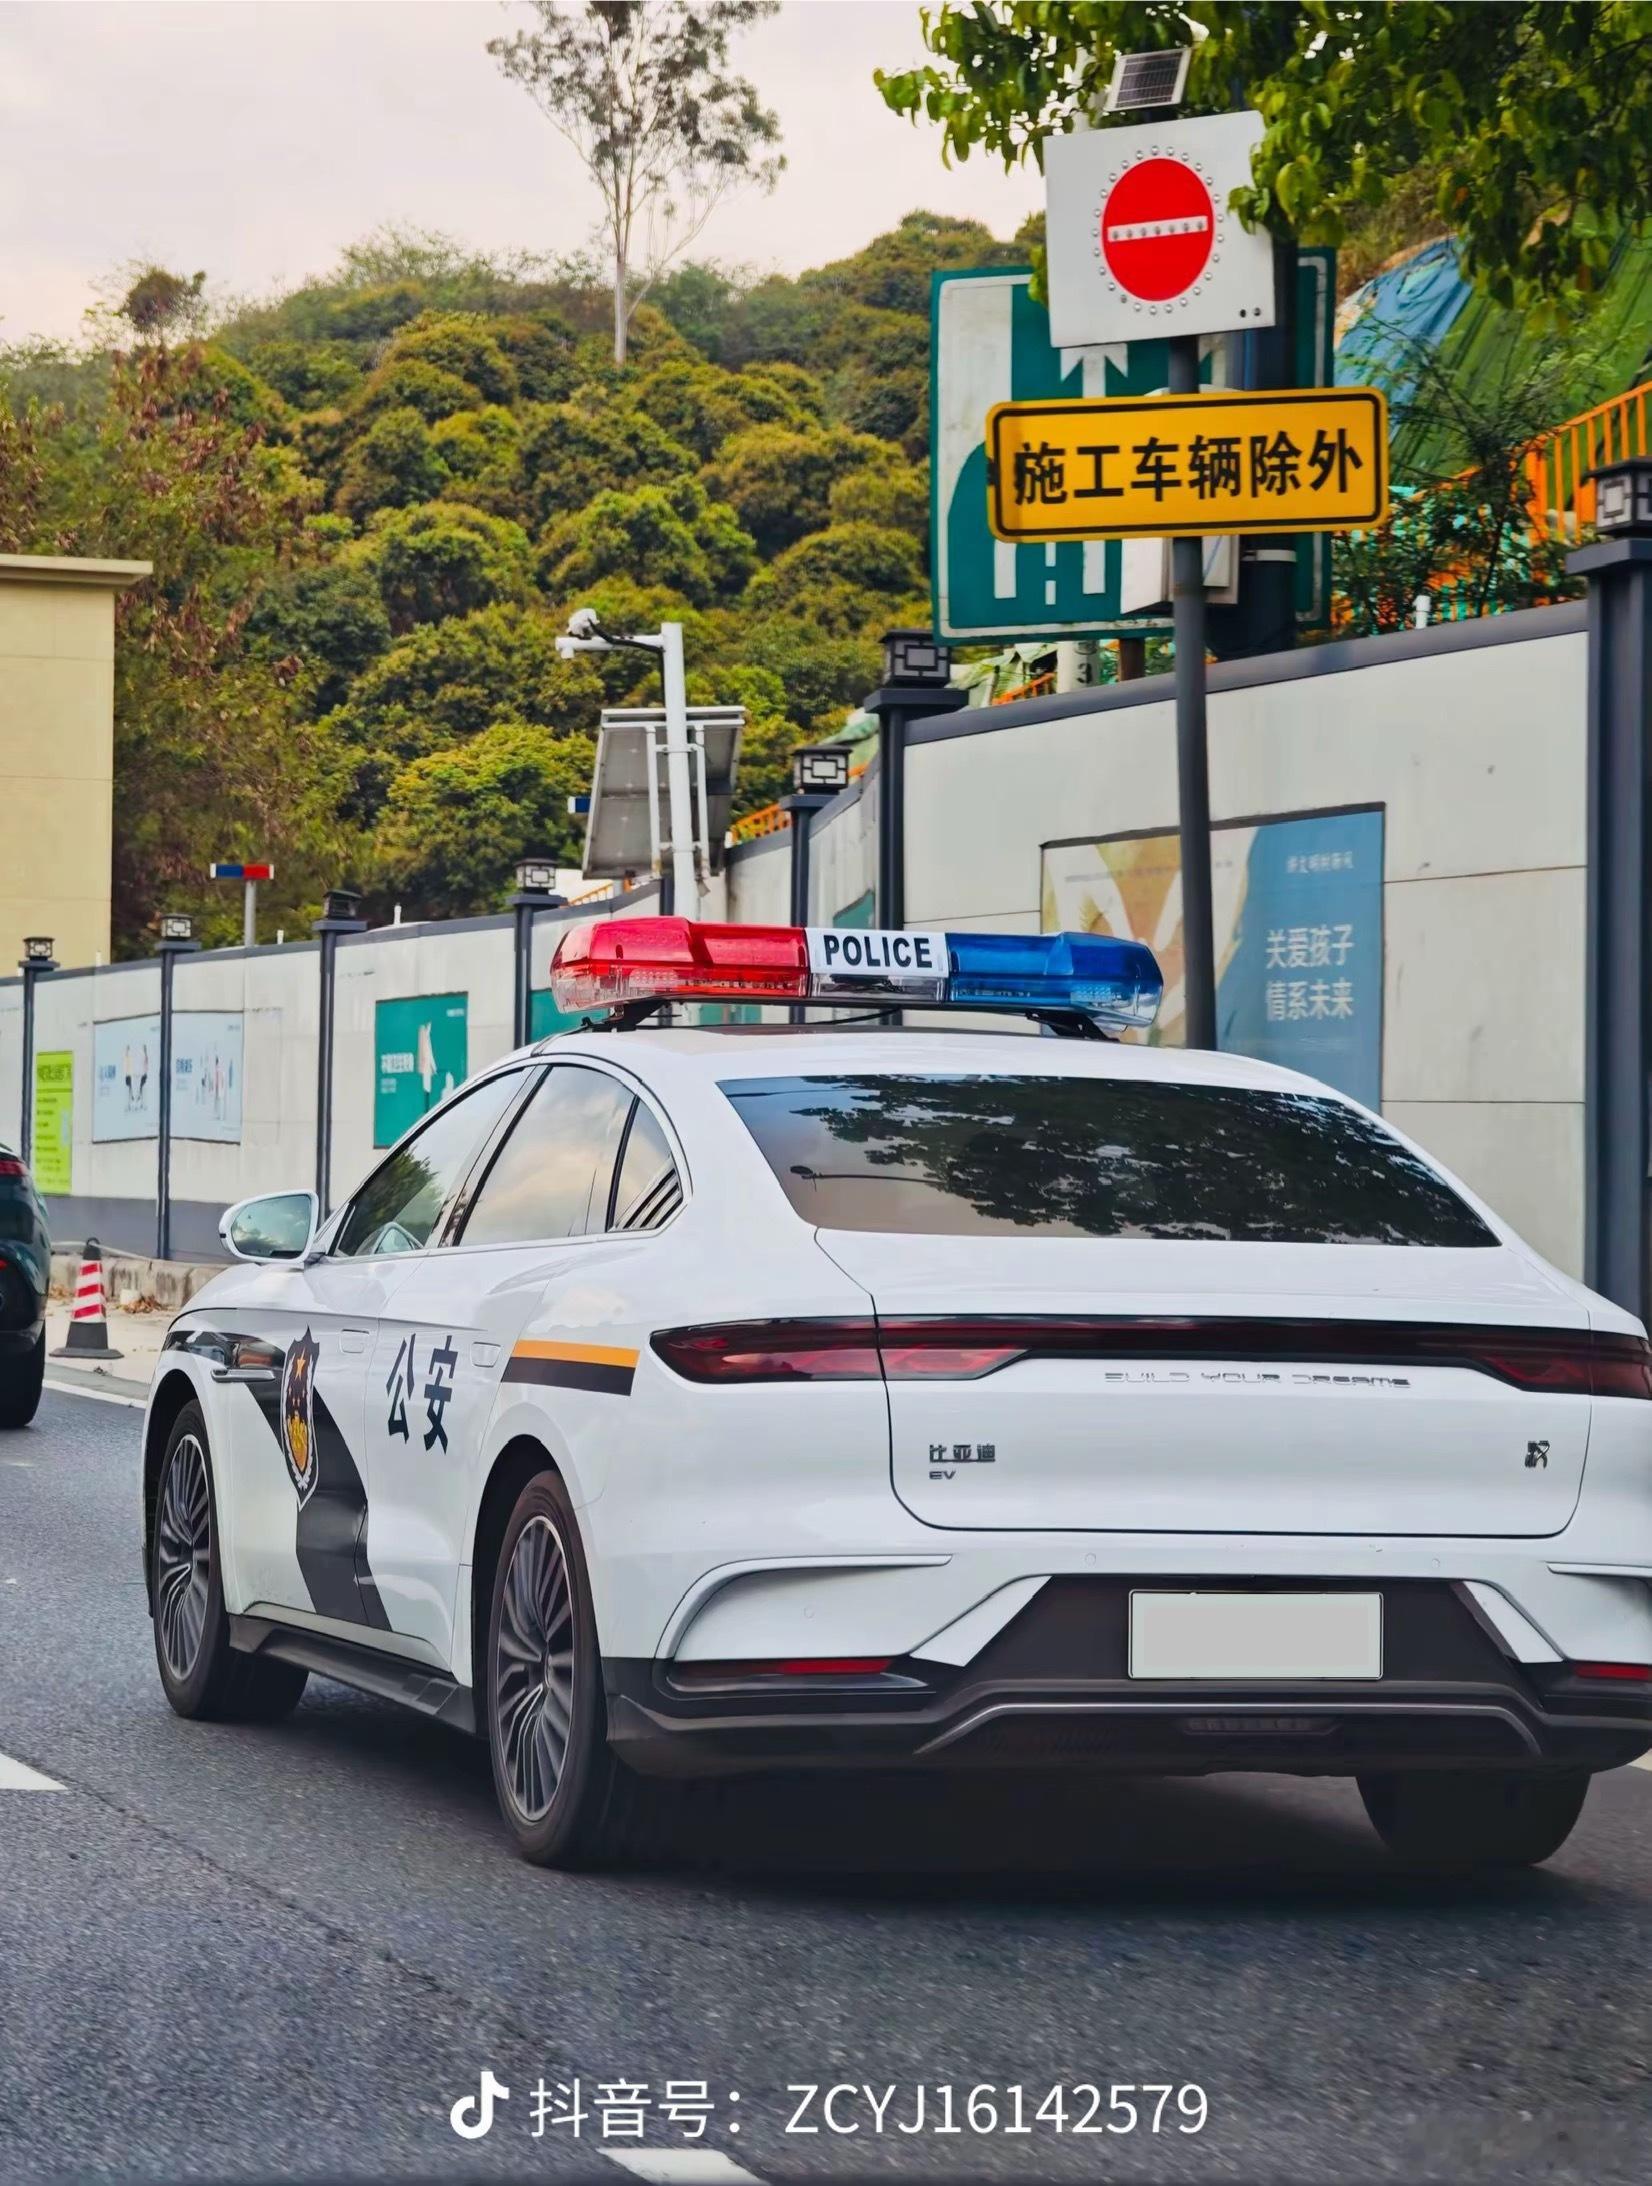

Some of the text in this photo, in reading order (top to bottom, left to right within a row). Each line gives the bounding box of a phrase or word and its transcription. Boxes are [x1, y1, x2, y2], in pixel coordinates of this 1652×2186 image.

[1014, 428, 1363, 505] 施工车辆除外
[823, 934, 933, 969] POLICE
[1265, 924, 1354, 969] 关爱孩子
[1265, 977, 1354, 1021] 情系未来
[386, 1333, 459, 1455] 公安
[1104, 1372, 1411, 1388] BUILD YOUR DREAMS
[929, 1443, 996, 1463] 比亚迪
[929, 1471, 956, 1480] EV
